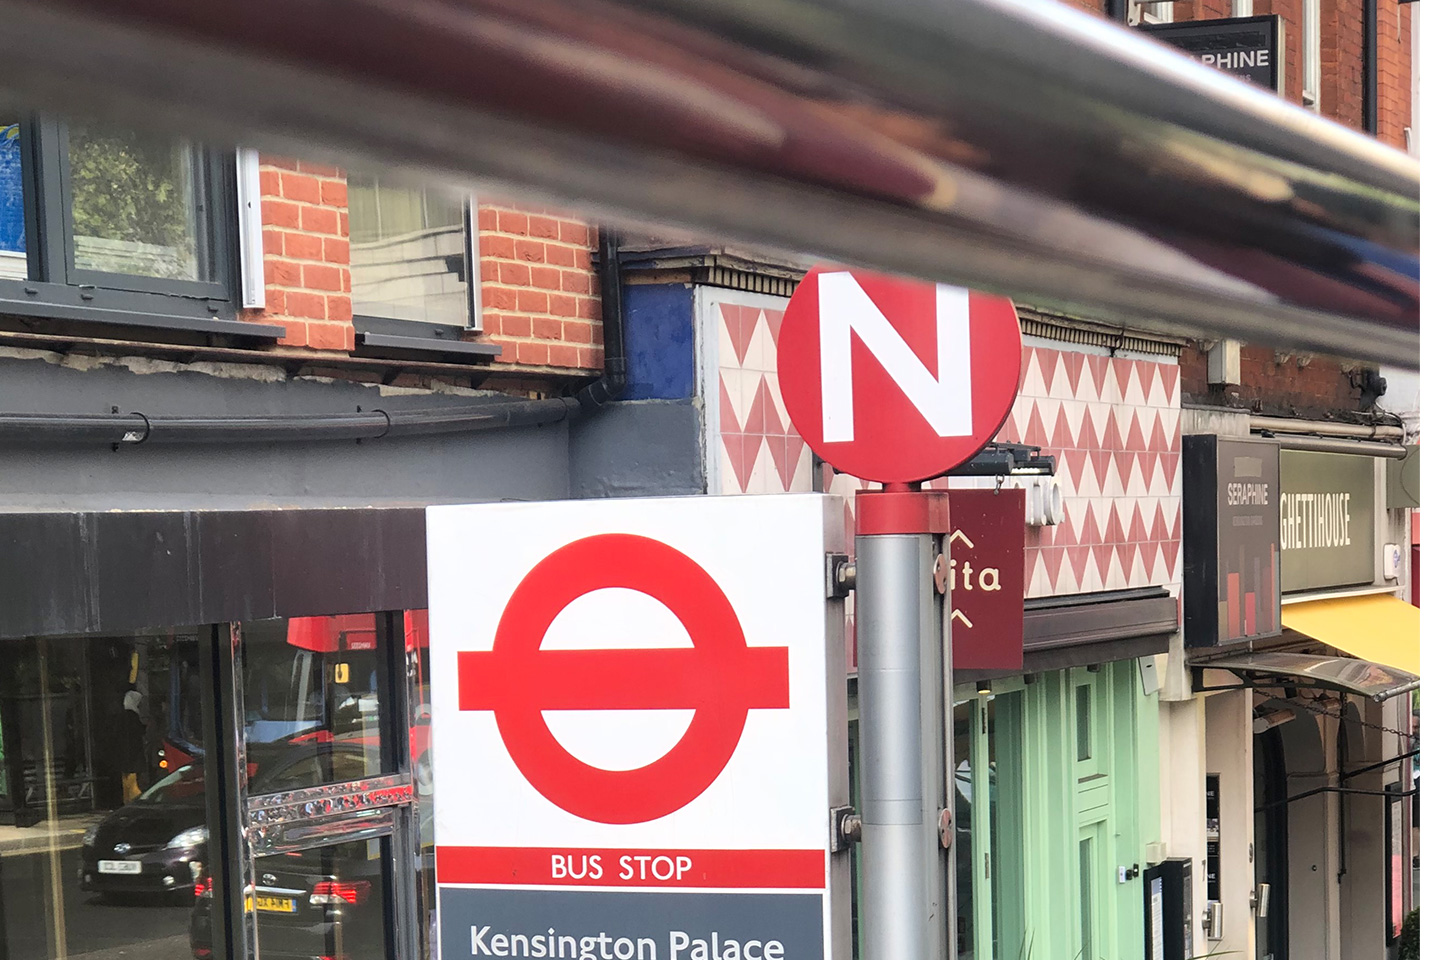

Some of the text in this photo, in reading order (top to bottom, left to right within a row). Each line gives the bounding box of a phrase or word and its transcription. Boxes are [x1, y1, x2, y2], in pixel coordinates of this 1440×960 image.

[817, 270, 973, 443] N
[1227, 482, 1269, 505] SERAPHINE
[551, 854, 692, 881] BUS STOP
